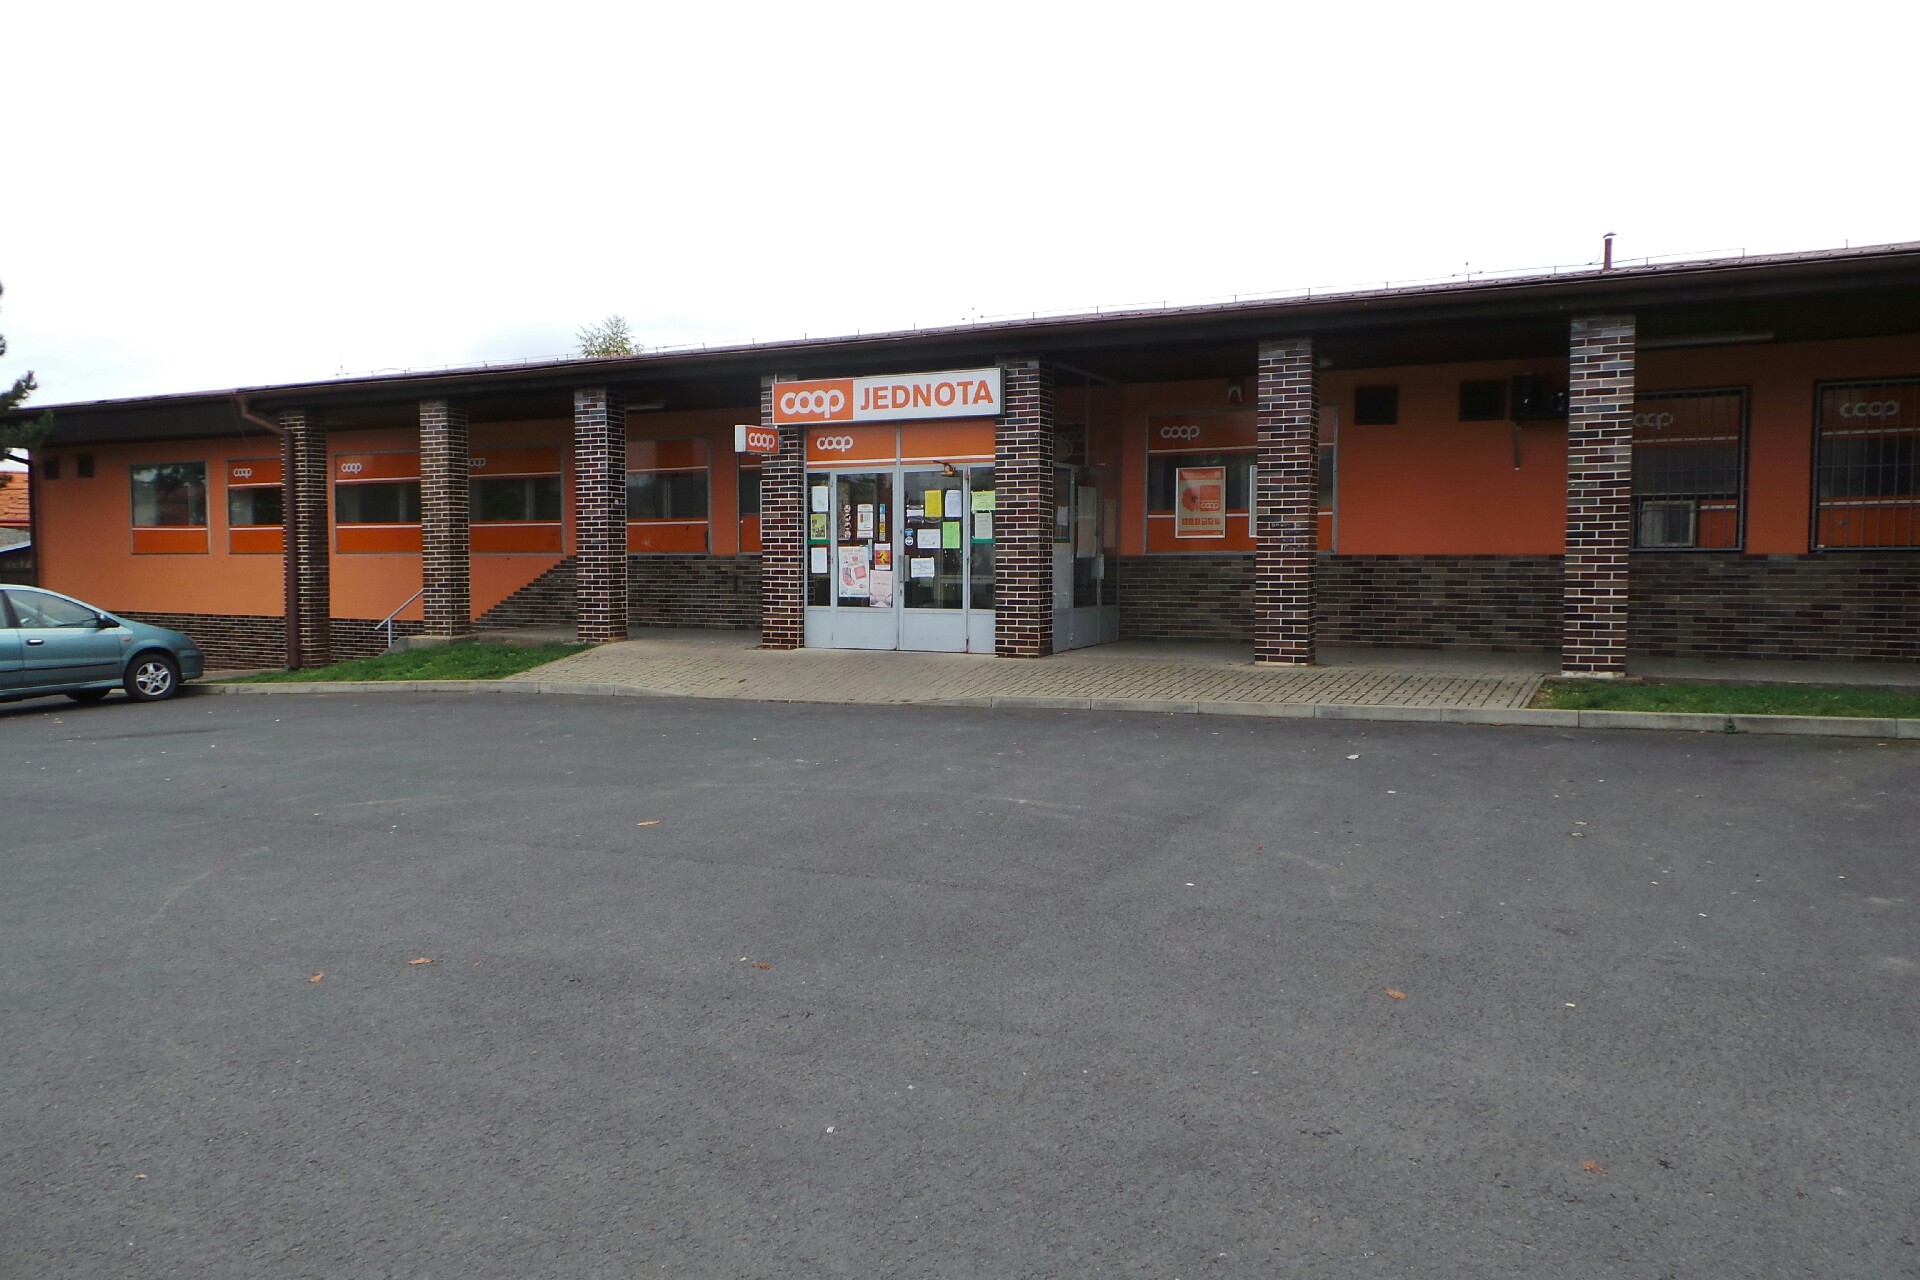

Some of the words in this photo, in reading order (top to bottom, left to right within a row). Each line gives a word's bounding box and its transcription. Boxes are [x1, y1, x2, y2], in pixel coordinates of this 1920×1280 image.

[780, 389, 845, 418] coop
[860, 379, 993, 411] JEDNOTA
[1840, 400, 1900, 419] coop
[1632, 412, 1674, 430] oop
[748, 433, 775, 450] coop
[1160, 425, 1200, 441] coop
[816, 435, 854, 452] coop
[341, 463, 361, 474] coop
[468, 457, 486, 468] oop
[233, 468, 251, 478] coop
